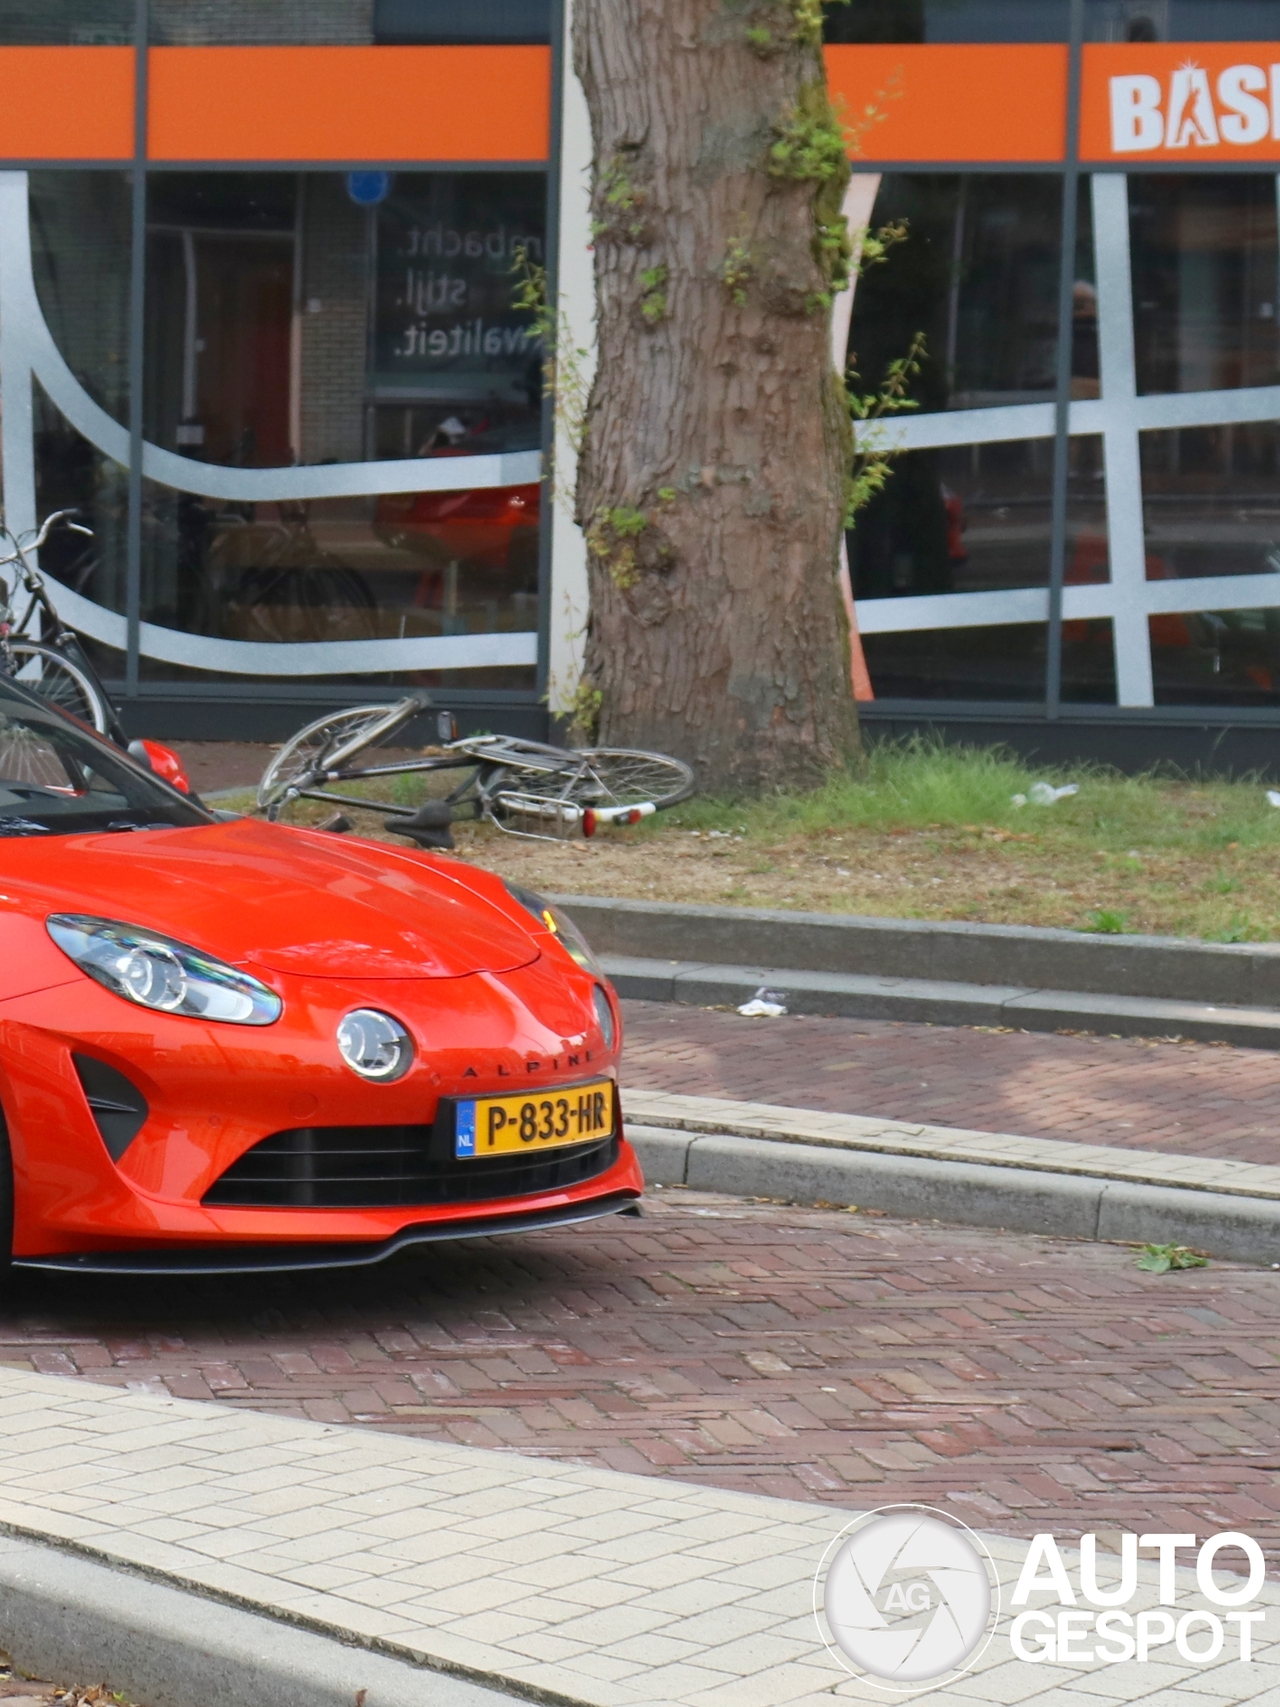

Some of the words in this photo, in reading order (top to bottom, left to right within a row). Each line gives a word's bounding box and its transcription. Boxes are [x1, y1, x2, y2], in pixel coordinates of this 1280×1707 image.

[463, 1049, 595, 1078] ALPINE
[487, 1091, 606, 1146] P-833-HR
[458, 1134, 473, 1147] NL
